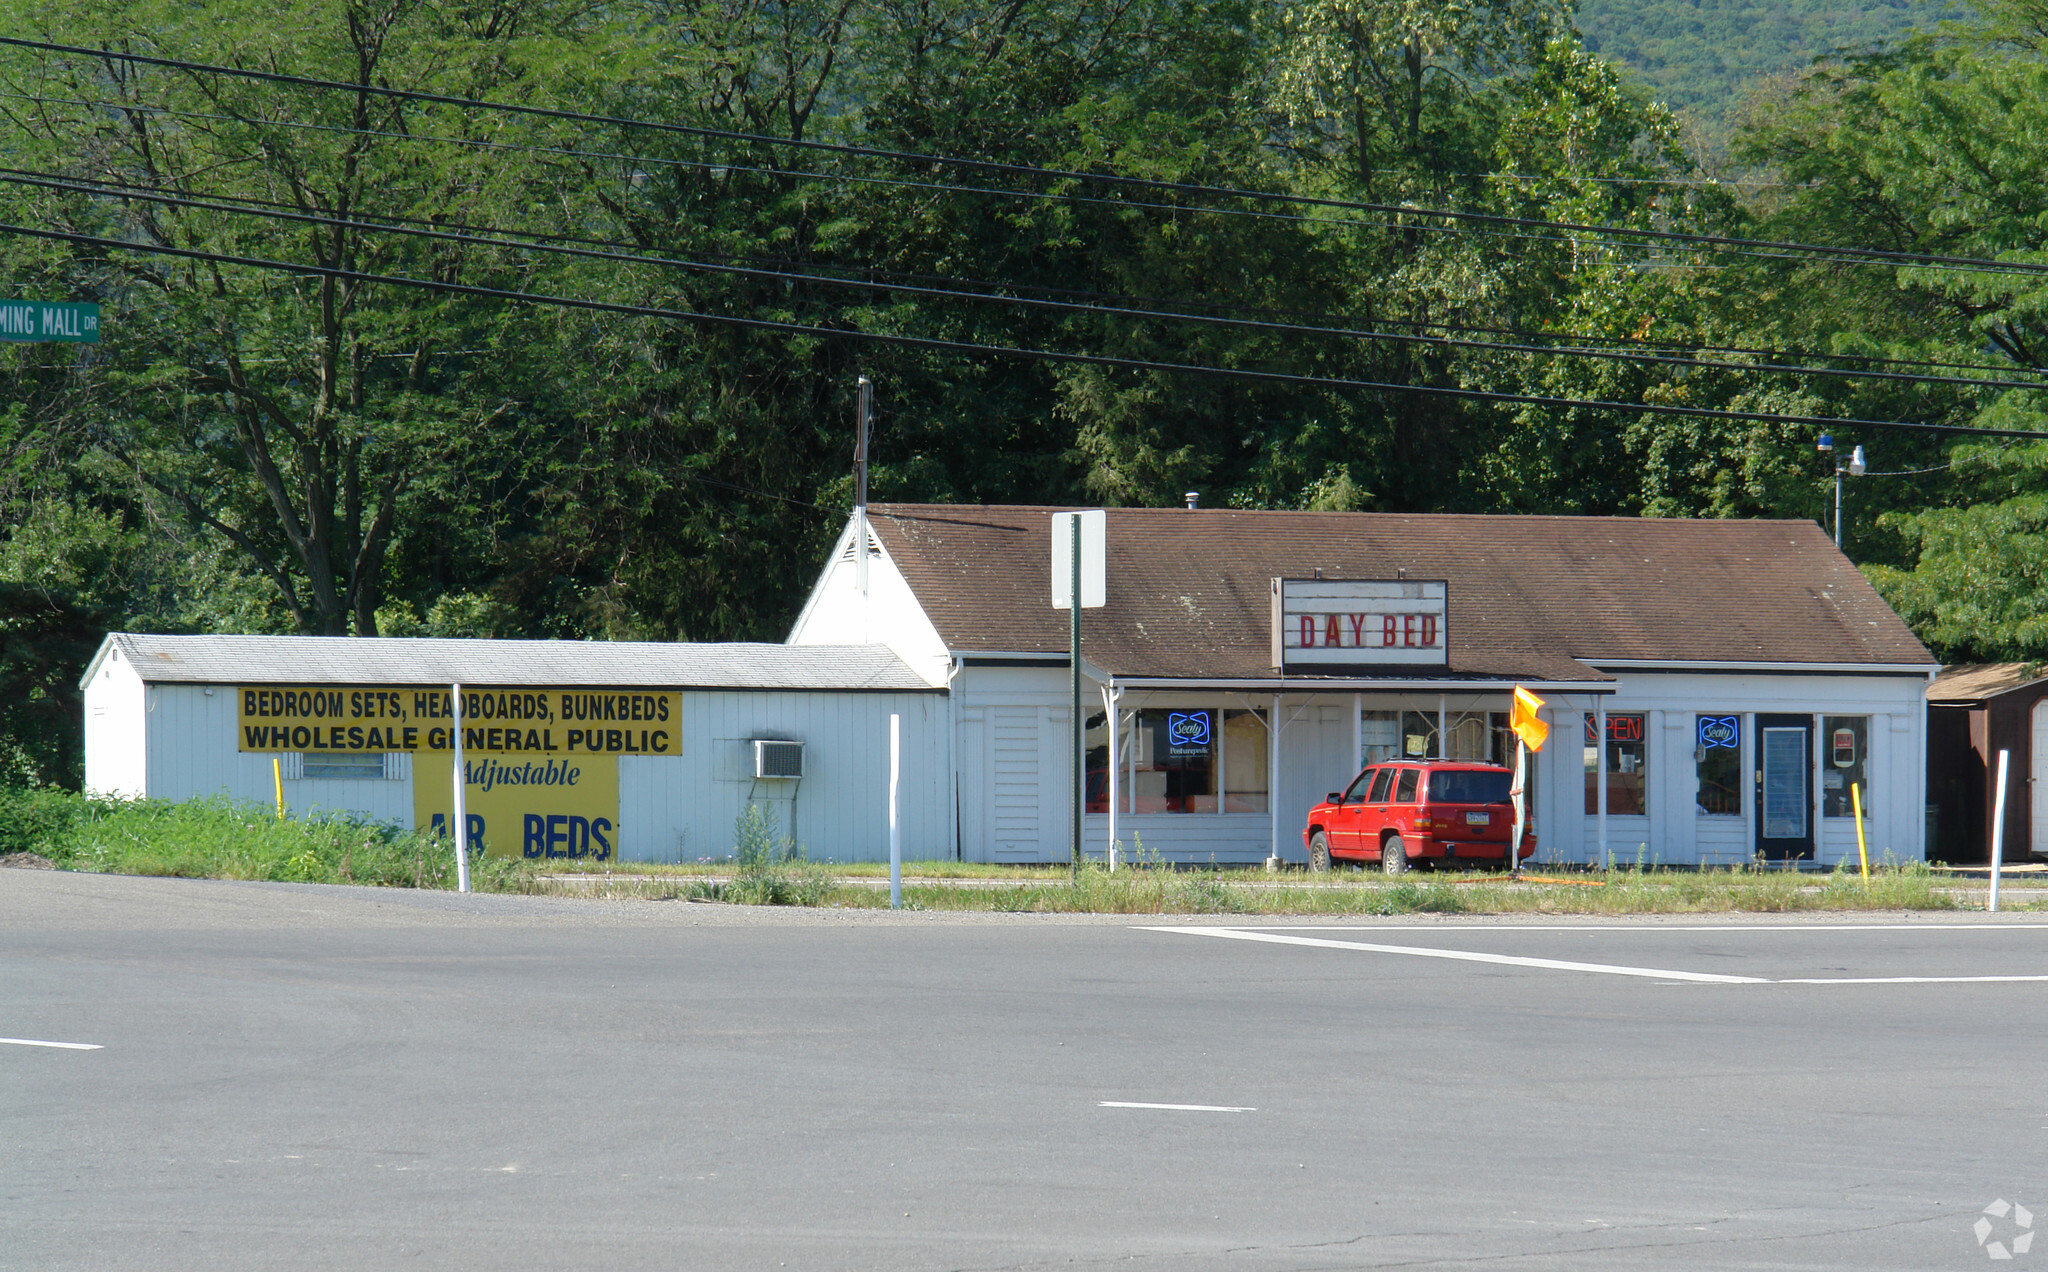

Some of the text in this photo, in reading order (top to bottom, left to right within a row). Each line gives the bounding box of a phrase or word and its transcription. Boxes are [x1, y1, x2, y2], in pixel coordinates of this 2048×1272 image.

[42, 307, 82, 336] MALL
[84, 316, 97, 330] DR
[1301, 614, 1436, 648] DAY BED
[244, 690, 344, 718] BEDROOM
[351, 692, 407, 723] SETS,
[561, 694, 669, 722] BUNKBEDS
[244, 726, 418, 749] WHOLESALE
[567, 729, 669, 752] PUBLIC
[1175, 722, 1202, 736] Sealy
[1705, 726, 1730, 740] Sealy
[464, 758, 580, 792] Adjustable
[523, 813, 612, 861] BEDS
